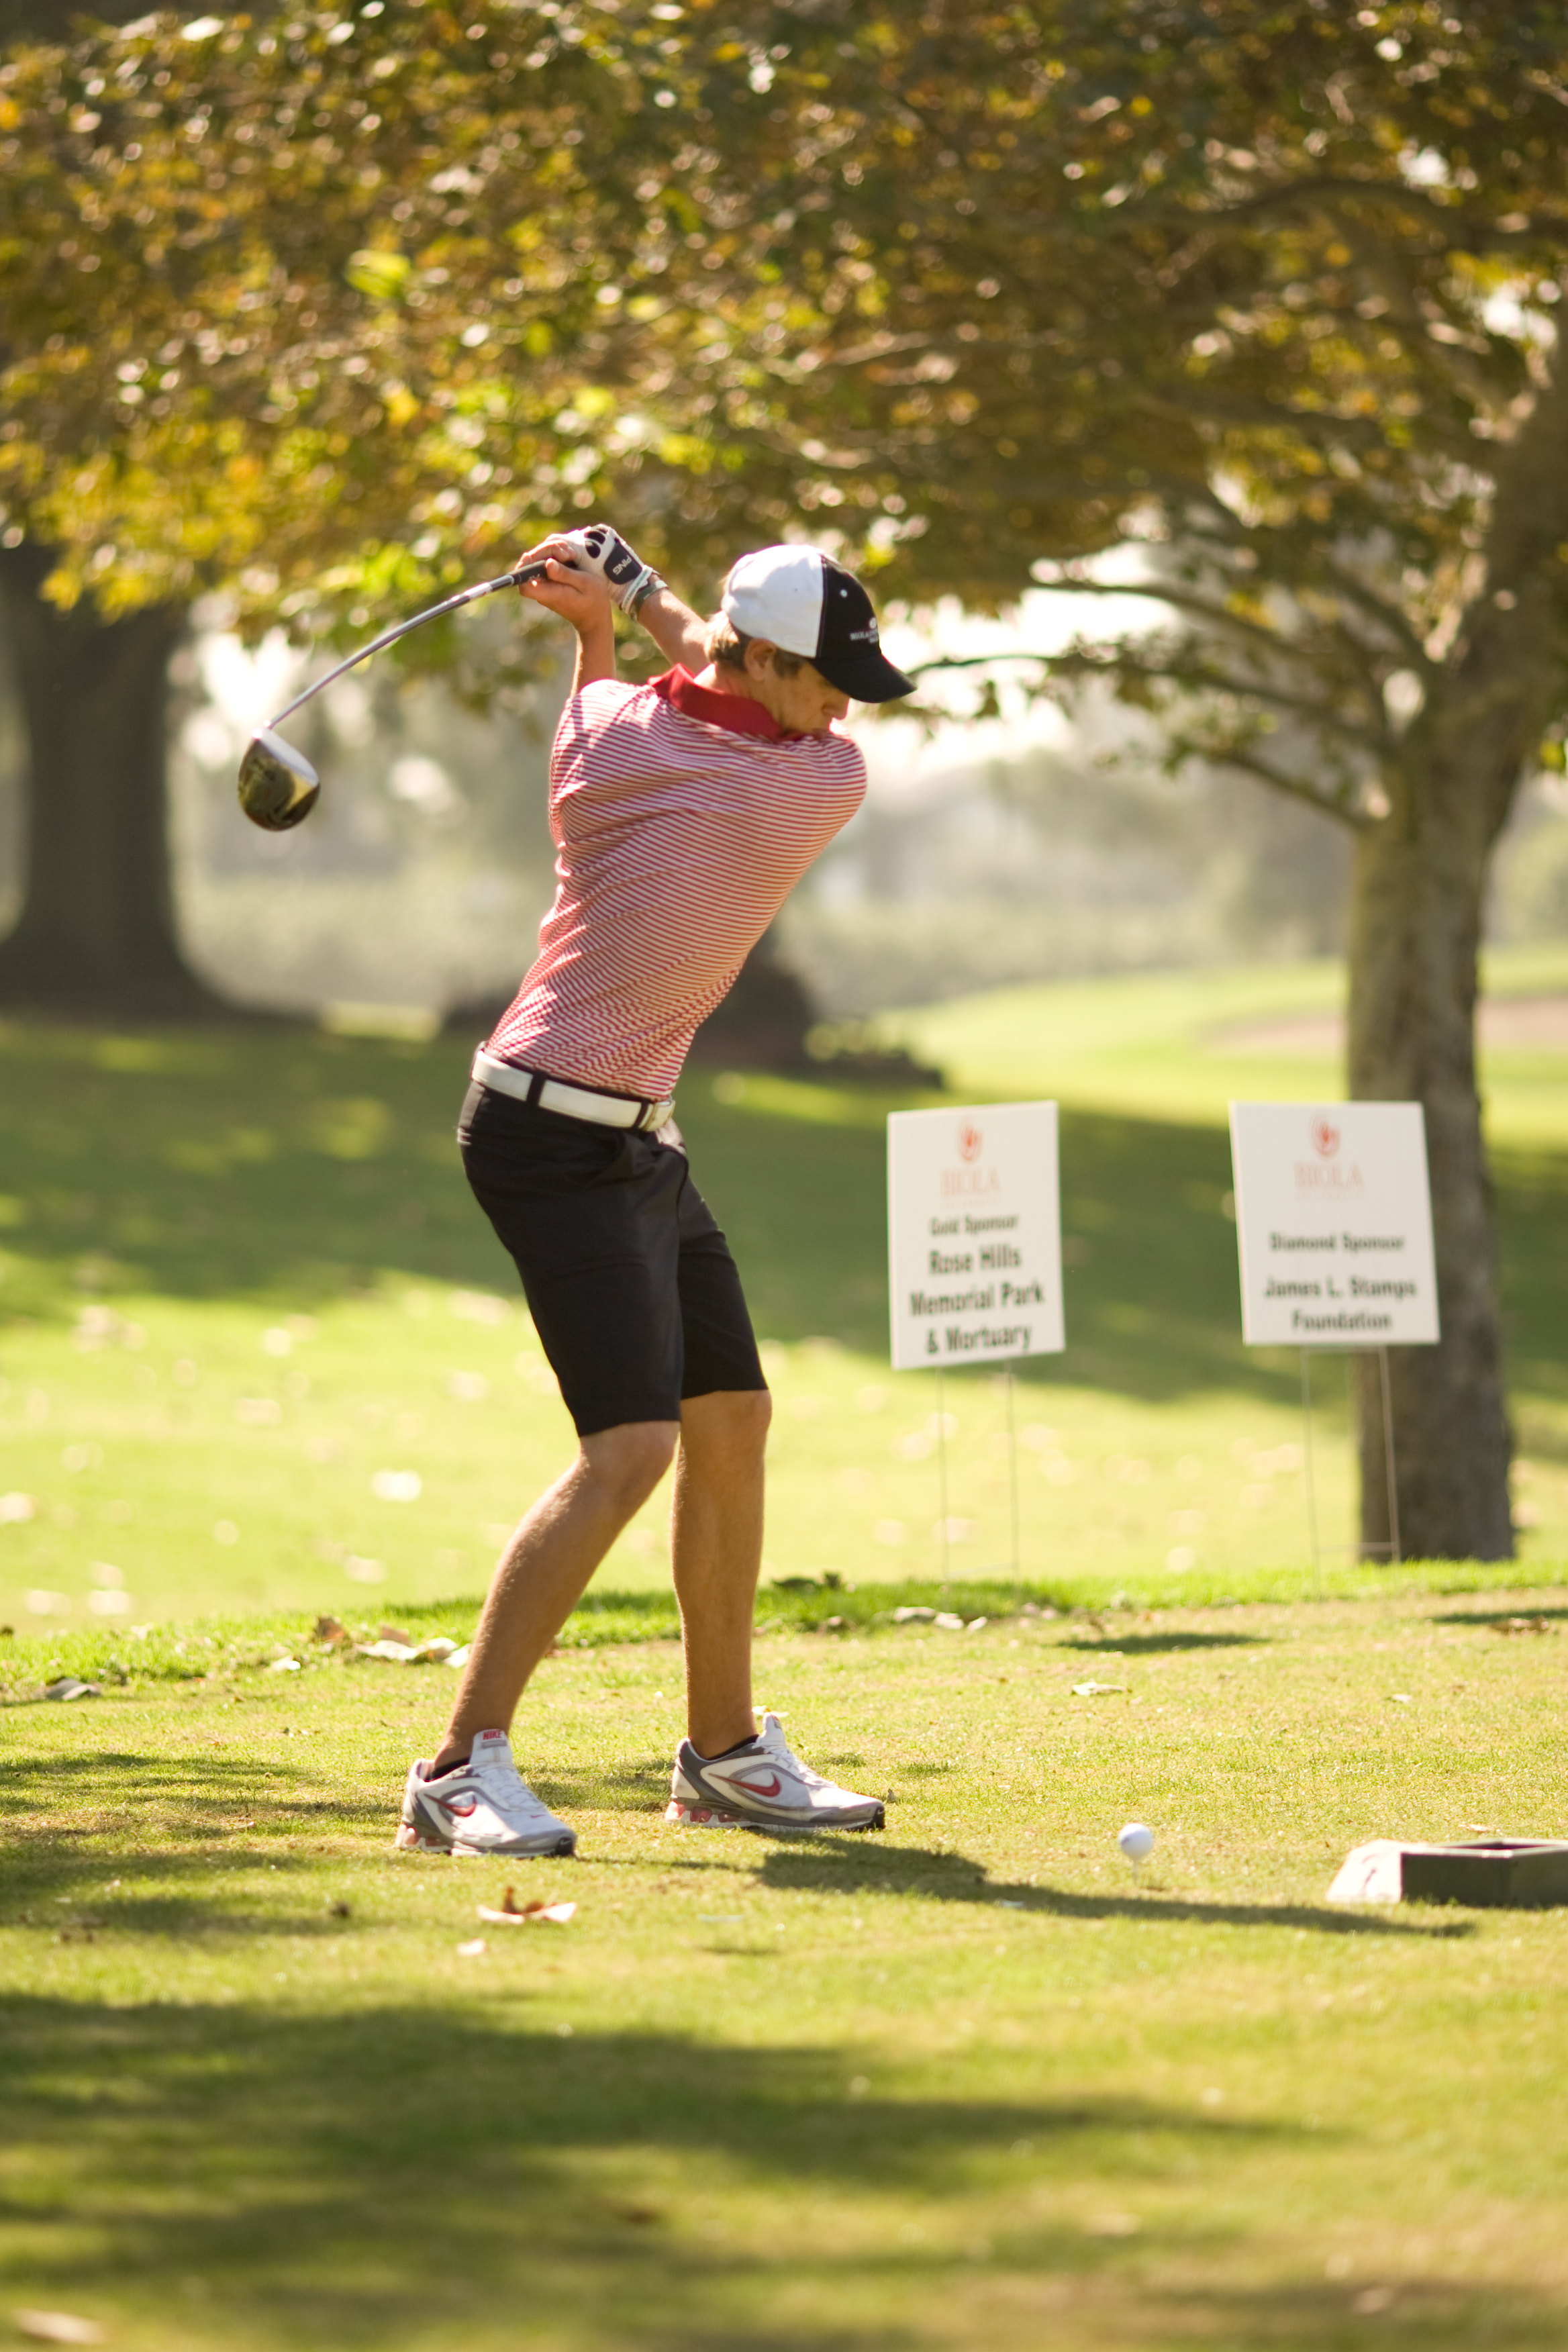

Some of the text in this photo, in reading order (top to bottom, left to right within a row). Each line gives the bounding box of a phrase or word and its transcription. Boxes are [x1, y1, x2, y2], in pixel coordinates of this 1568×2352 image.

[612, 555, 633, 576] PING
[965, 1215, 1019, 1235] Sponsor
[1270, 1232, 1404, 1253] Diamond Sponsor
[930, 1245, 1021, 1274] Rose Hills
[910, 1281, 1045, 1316] Memorial Park
[1264, 1277, 1416, 1301] James L. Stamps
[1293, 1310, 1391, 1331] Foundation
[946, 1324, 1032, 1354] Mortuary
[483, 1730, 501, 1741] NIKE
